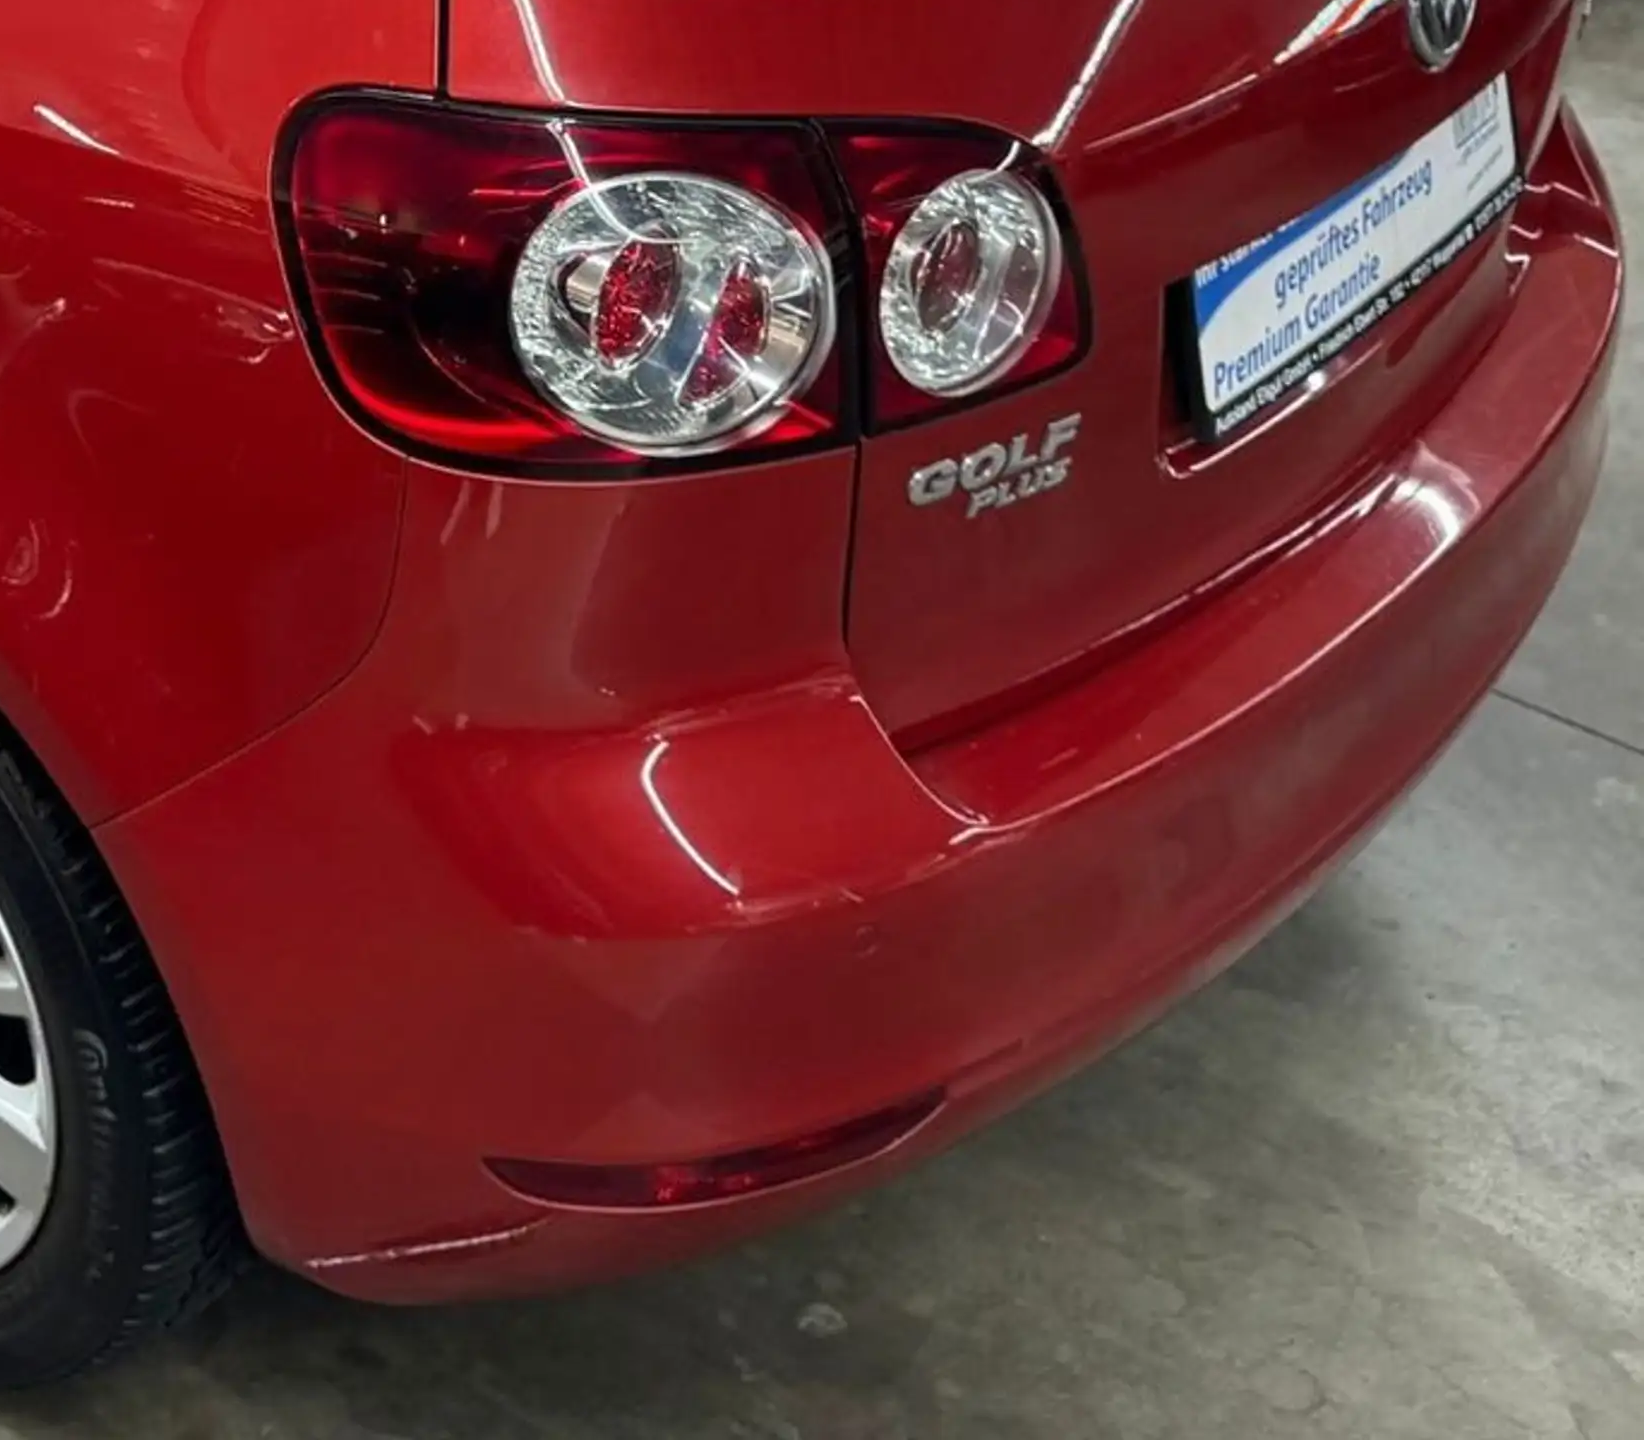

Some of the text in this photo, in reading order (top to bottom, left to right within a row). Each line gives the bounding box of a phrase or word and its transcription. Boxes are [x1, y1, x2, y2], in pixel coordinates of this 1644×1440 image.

[1274, 216, 1360, 310] geprüftes
[1362, 160, 1432, 235] Fahrzeug
[1214, 251, 1381, 401] Premium Garantie
[907, 412, 1081, 506] GOLF
[965, 456, 1073, 519] PLUS
